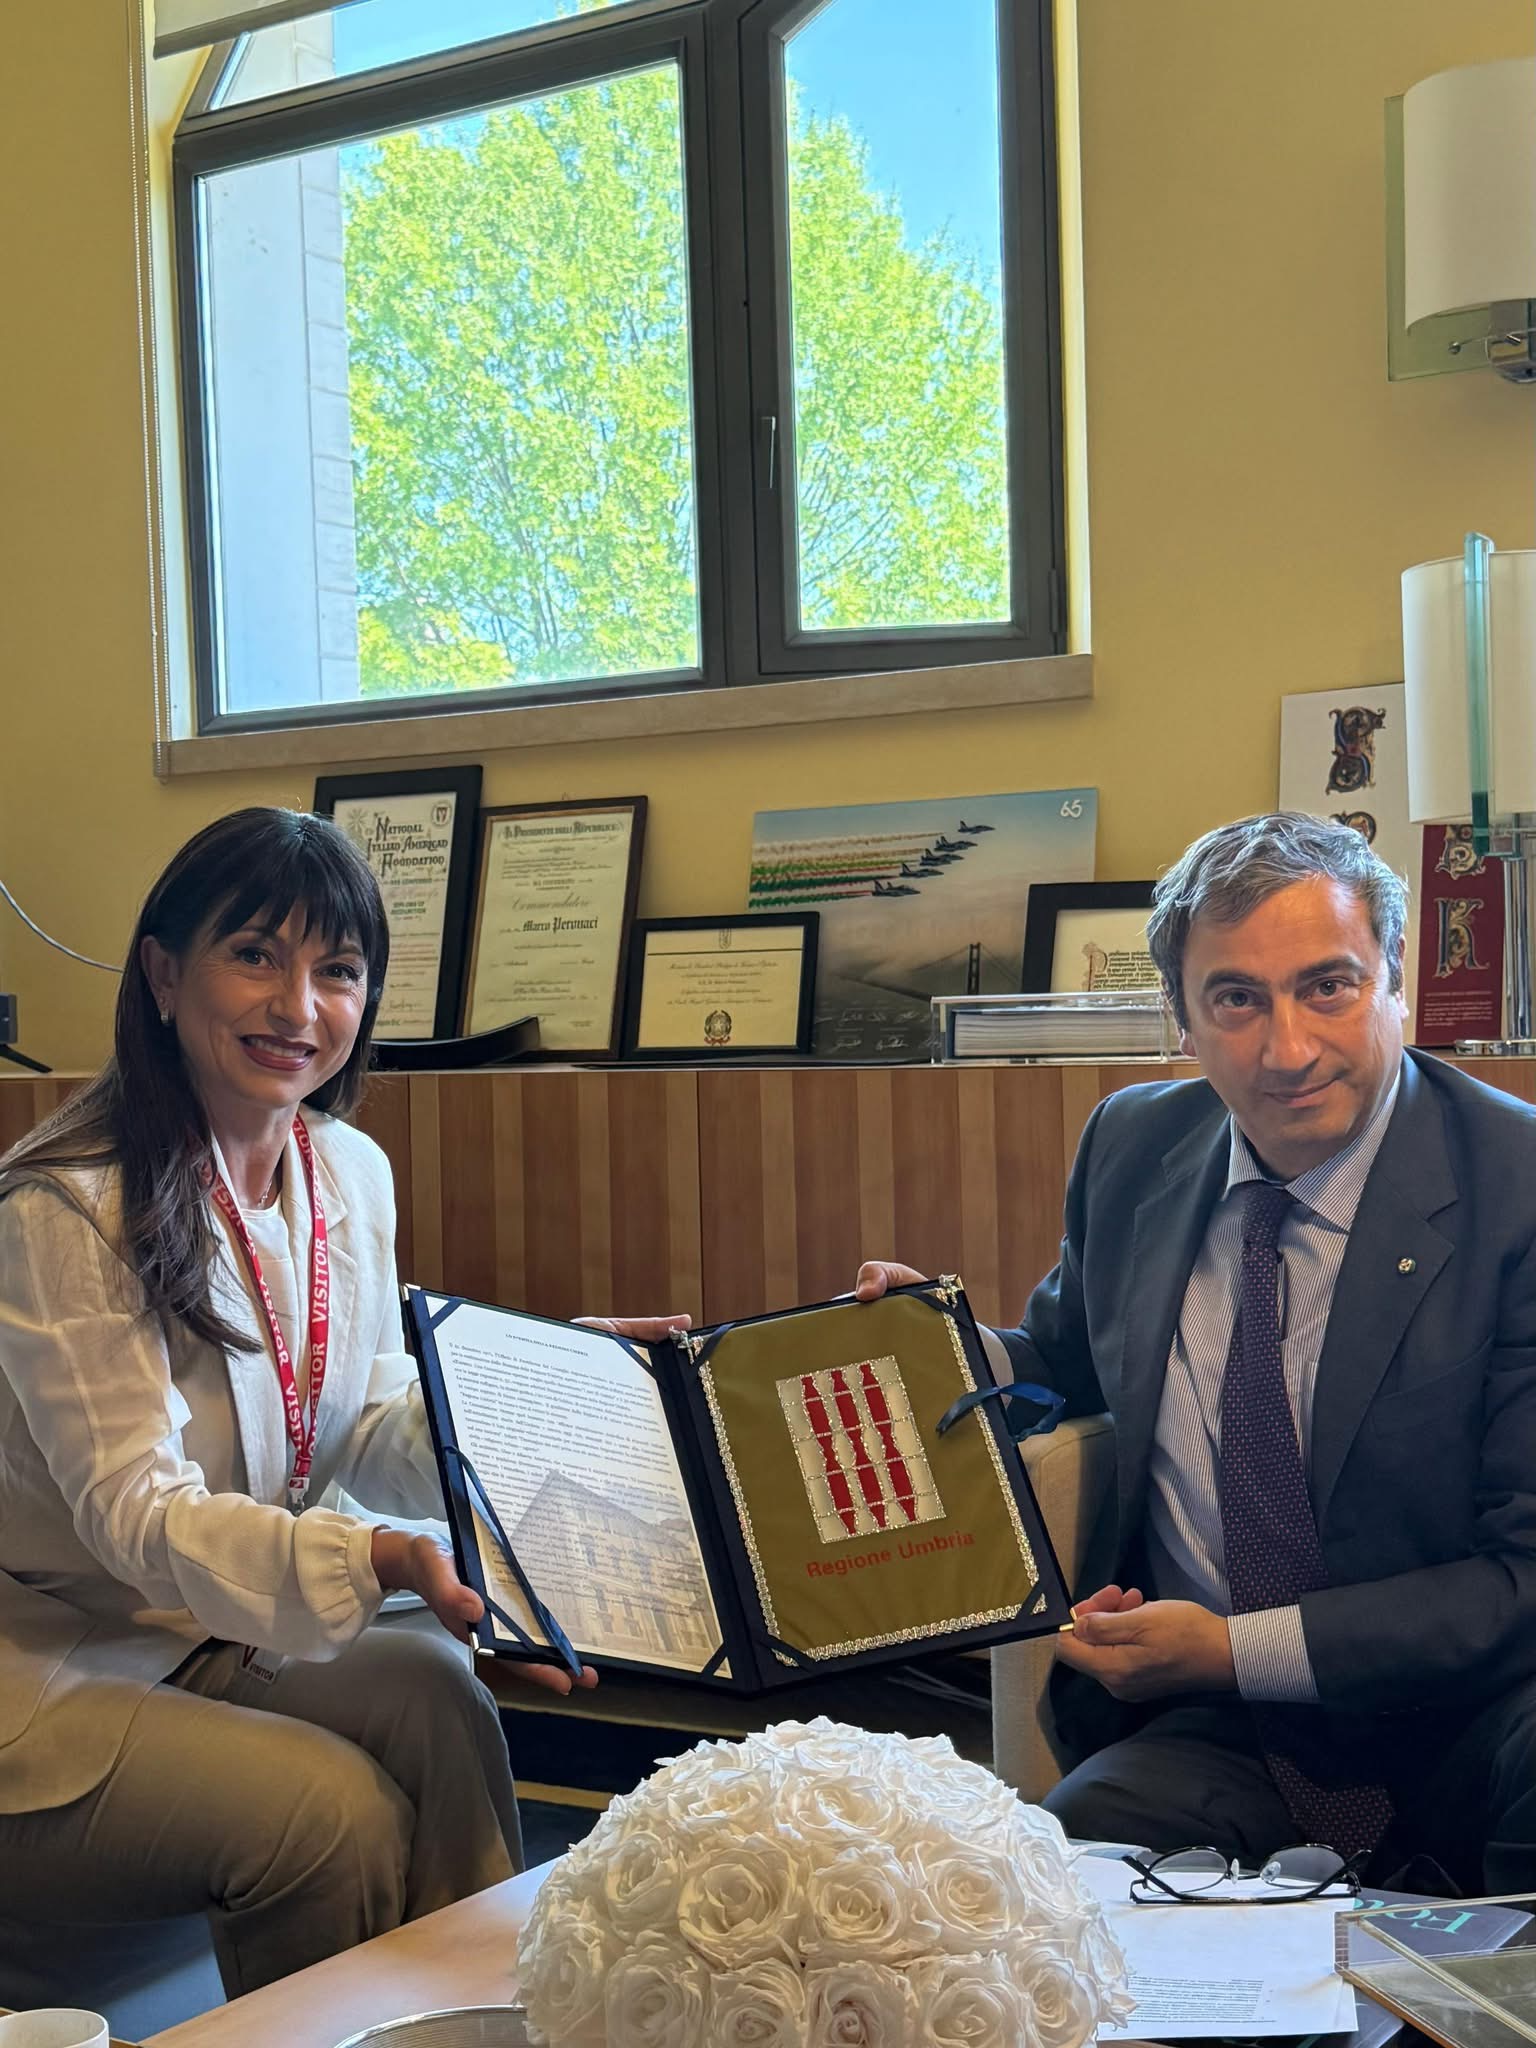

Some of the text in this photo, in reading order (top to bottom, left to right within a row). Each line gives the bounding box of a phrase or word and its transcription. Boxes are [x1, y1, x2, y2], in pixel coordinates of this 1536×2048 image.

[376, 816, 424, 842] NATIONAL
[1060, 799, 1083, 818] 65
[312, 1238, 328, 1323] VISITOR
[260, 1275, 289, 1367] VISITOR
[807, 1530, 976, 1579] Regione Umbria
